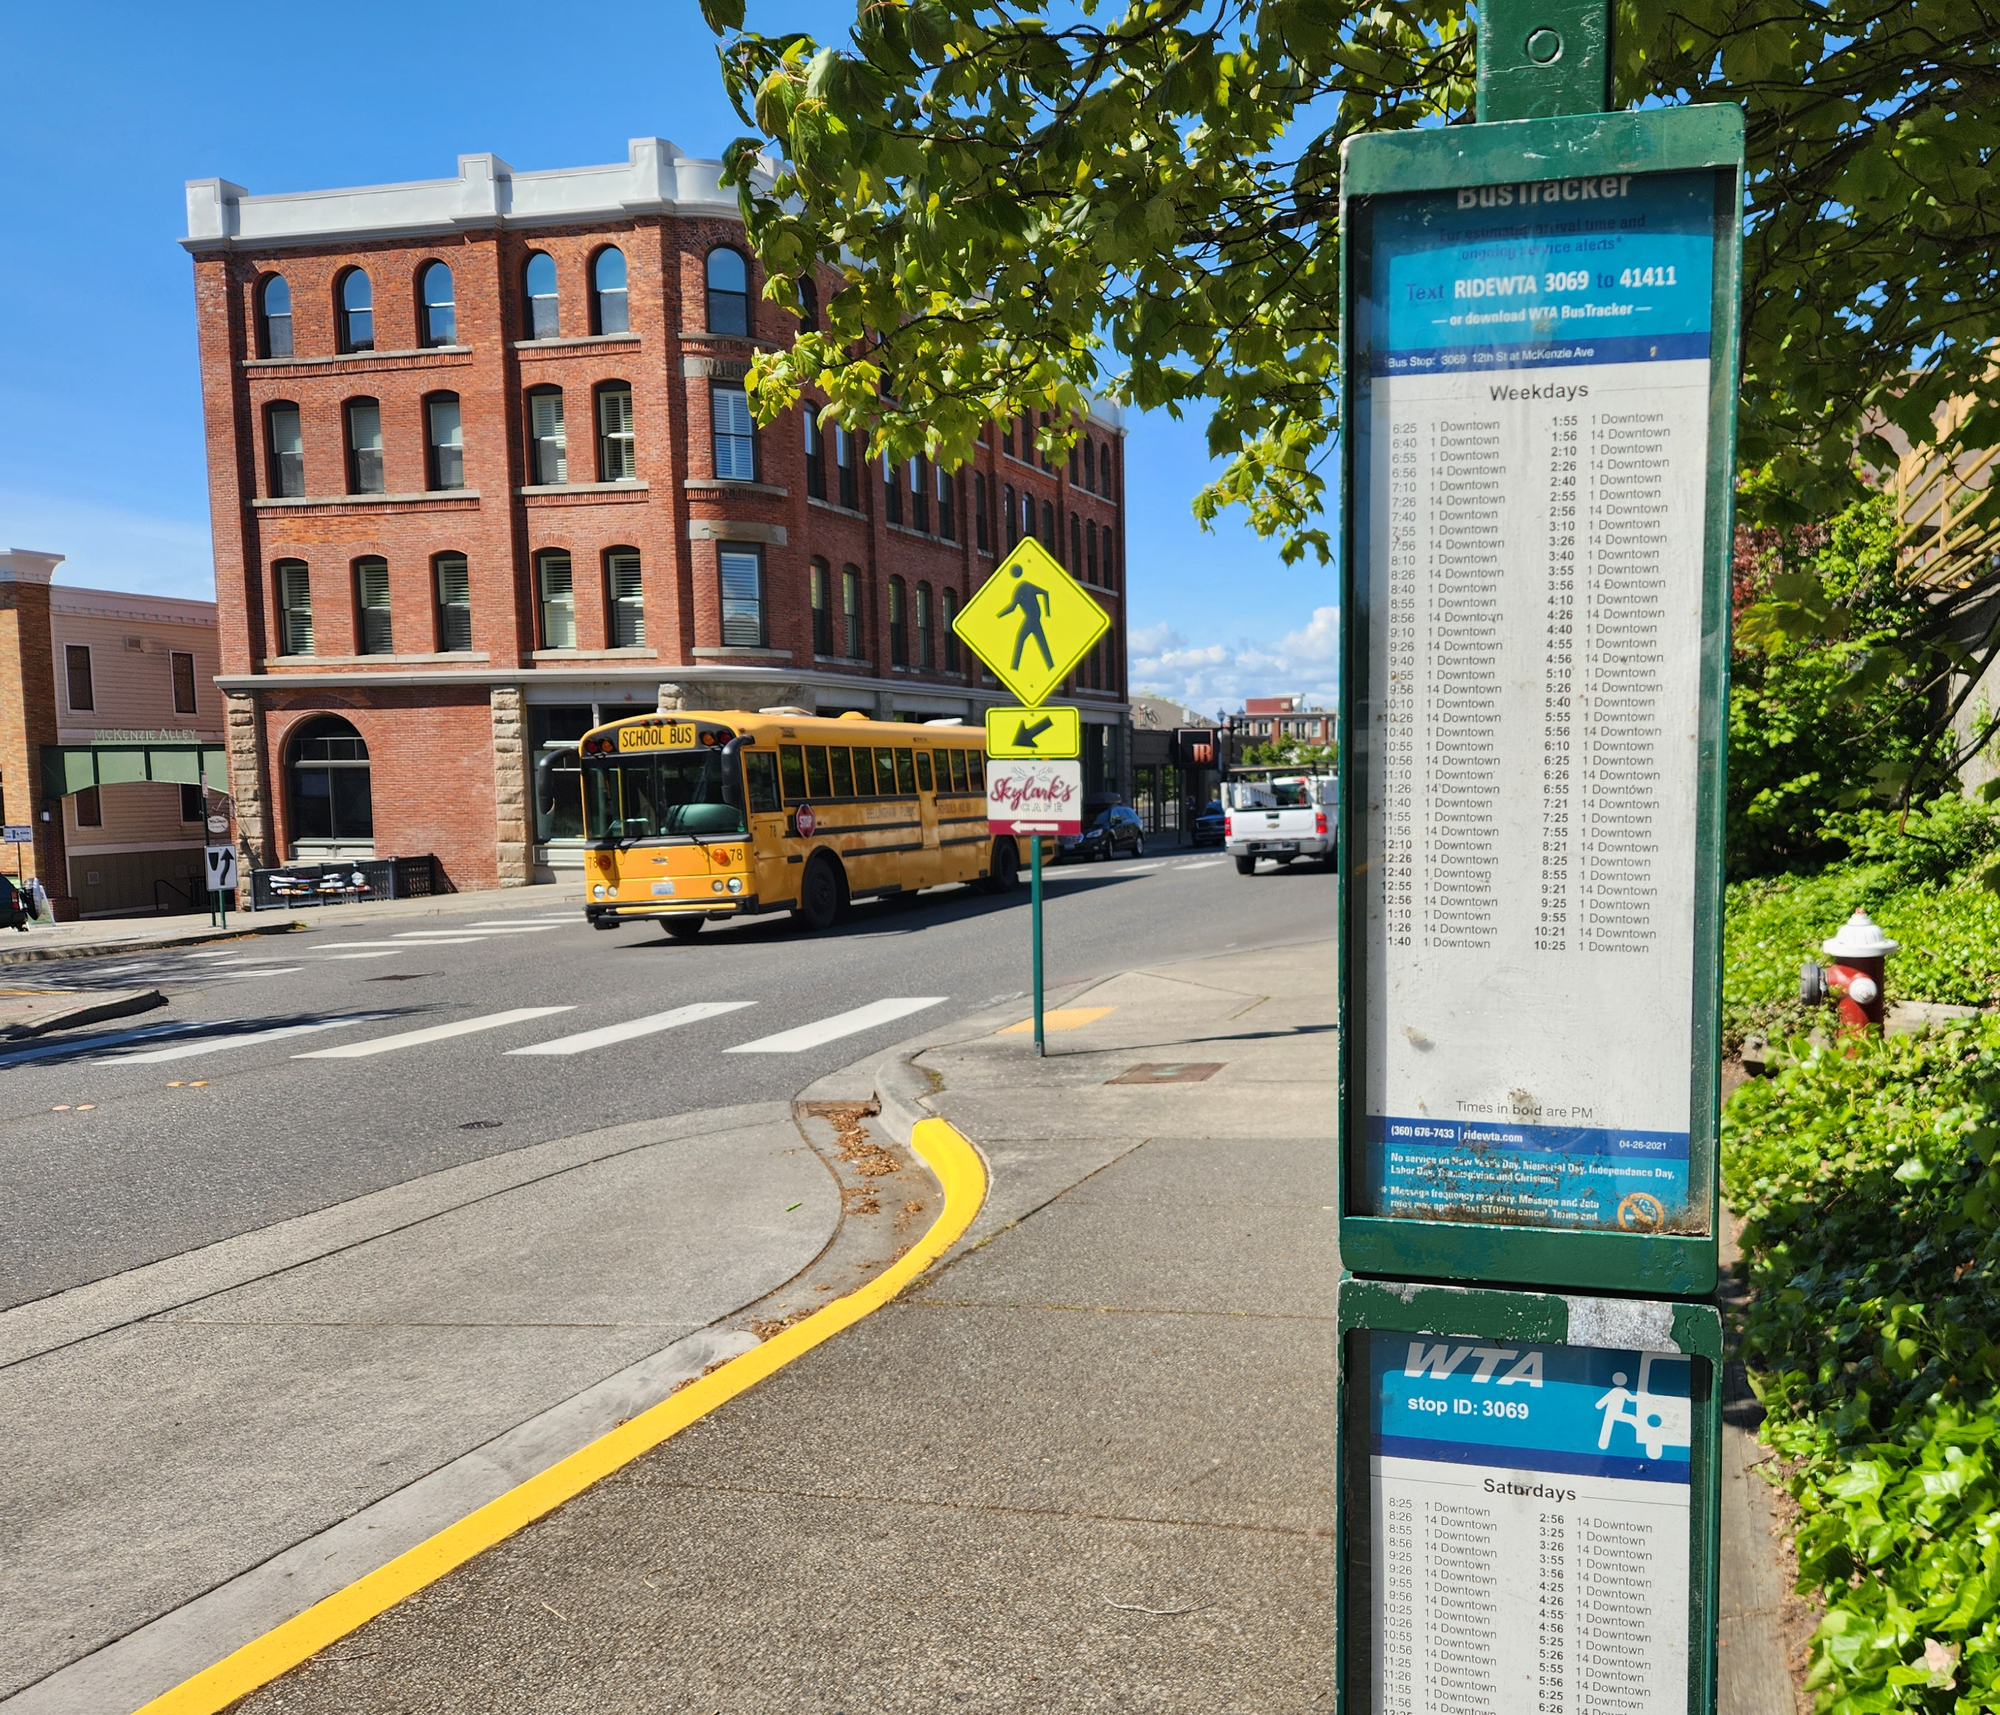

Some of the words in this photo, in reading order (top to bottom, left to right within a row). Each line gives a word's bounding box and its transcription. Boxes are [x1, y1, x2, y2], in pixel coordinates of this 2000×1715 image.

[1585, 217, 1615, 230] time
[1620, 213, 1646, 228] and
[1462, 246, 1515, 261] ongoing
[1406, 283, 1444, 300] Text
[1454, 275, 1538, 299] RIDEWTA
[1544, 270, 1590, 292] 3069
[1596, 273, 1614, 289] to
[1619, 266, 1677, 289] 41411
[1450, 316, 1462, 326] or
[1465, 311, 1526, 325] download
[1529, 307, 1557, 321] WTA
[1561, 303, 1634, 319] BusTracker
[1388, 358, 1408, 368] Bus
[1410, 357, 1435, 370] Stop:
[1441, 355, 1467, 365] 3069
[1472, 353, 1493, 363] 12th
[1496, 352, 1508, 361] St
[1509, 351, 1520, 361] at
[1522, 348, 1572, 361] McKenzie
[1573, 347, 1595, 357] Ave
[1490, 383, 1589, 402] Weekdays
[1393, 423, 1417, 434] 6:25
[1440, 421, 1500, 432] Downtown
[1551, 431, 1577, 442] 1:56
[1591, 429, 1604, 441] 14
[1608, 428, 1671, 440] Downtown
[1392, 482, 1417, 493] 7:10
[1439, 481, 1499, 491] Downtown
[1550, 476, 1576, 487] 2:40
[1600, 474, 1662, 485] Downtown
[1391, 570, 1415, 580] 8:26
[1429, 569, 1441, 579] 14
[1445, 569, 1504, 579] Downtown
[1548, 565, 1574, 576] 3:55
[1598, 564, 1659, 575] Downtown
[1547, 610, 1573, 620] 4:26
[1587, 609, 1599, 620] 14
[1603, 608, 1665, 619] Downtown
[1390, 656, 1414, 667] 9:40
[1437, 655, 1496, 666] Downtown
[1545, 712, 1571, 722] 5:55
[1593, 711, 1655, 722] Downtown
[160, 728, 197, 740] ALLEY
[622, 730, 665, 748] SCHOOL
[670, 727, 692, 744] BUS
[1383, 741, 1413, 751] 10:55
[1436, 741, 1494, 752] Downtown
[989, 775, 1078, 811] Skylark's
[1543, 799, 1568, 809] 7:21
[1582, 799, 1595, 809] 14
[1599, 799, 1660, 809] Downtown
[1383, 826, 1411, 835] 11:56
[1425, 826, 1437, 836] 14
[1441, 826, 1499, 837] Downtown
[729, 849, 743, 861] 78
[588, 857, 598, 869] 78
[1388, 909, 1412, 918] 1:10
[1434, 909, 1491, 920] Downtown
[1534, 940, 1566, 951] 10:25
[1589, 941, 1649, 953] Downtown
[1456, 1101, 1493, 1113] Times
[1497, 1102, 1508, 1113] in
[1547, 1107, 1566, 1117] are
[1571, 1107, 1593, 1118] PM
[1391, 1125, 1413, 1137] (360)
[1414, 1127, 1455, 1139] 676-7433
[1463, 1130, 1523, 1143] ridewta.com
[1619, 1140, 1667, 1150] 04-26-2021
[1390, 1152, 1403, 1162] No
[1518, 1195, 1559, 1207] Message
[1561, 1198, 1578, 1207] and
[1481, 1205, 1505, 1215] STOP
[1507, 1207, 1516, 1215] to
[1404, 1341, 1544, 1388] WTA
[1407, 1397, 1448, 1415] stop
[1453, 1399, 1478, 1415] ID:
[1482, 1401, 1529, 1419] 3069
[1483, 1478, 1577, 1502] Saturdays
[1389, 1498, 1412, 1509] 8:25
[1434, 1502, 1491, 1517] Downtown
[1539, 1526, 1564, 1538] 3:25
[1586, 1530, 1646, 1546] Downtown
[1389, 1564, 1412, 1575] 9:26
[1425, 1568, 1438, 1579] 14
[1441, 1568, 1498, 1585] Downtown
[1539, 1594, 1564, 1606] 4:26
[1576, 1598, 1590, 1609] 14
[1593, 1599, 1652, 1616] Downtown
[1383, 1630, 1412, 1642] 10:55
[1434, 1635, 1490, 1652] Downtown
[1539, 1662, 1564, 1674] 5:55
[1586, 1666, 1645, 1683] Downtown
